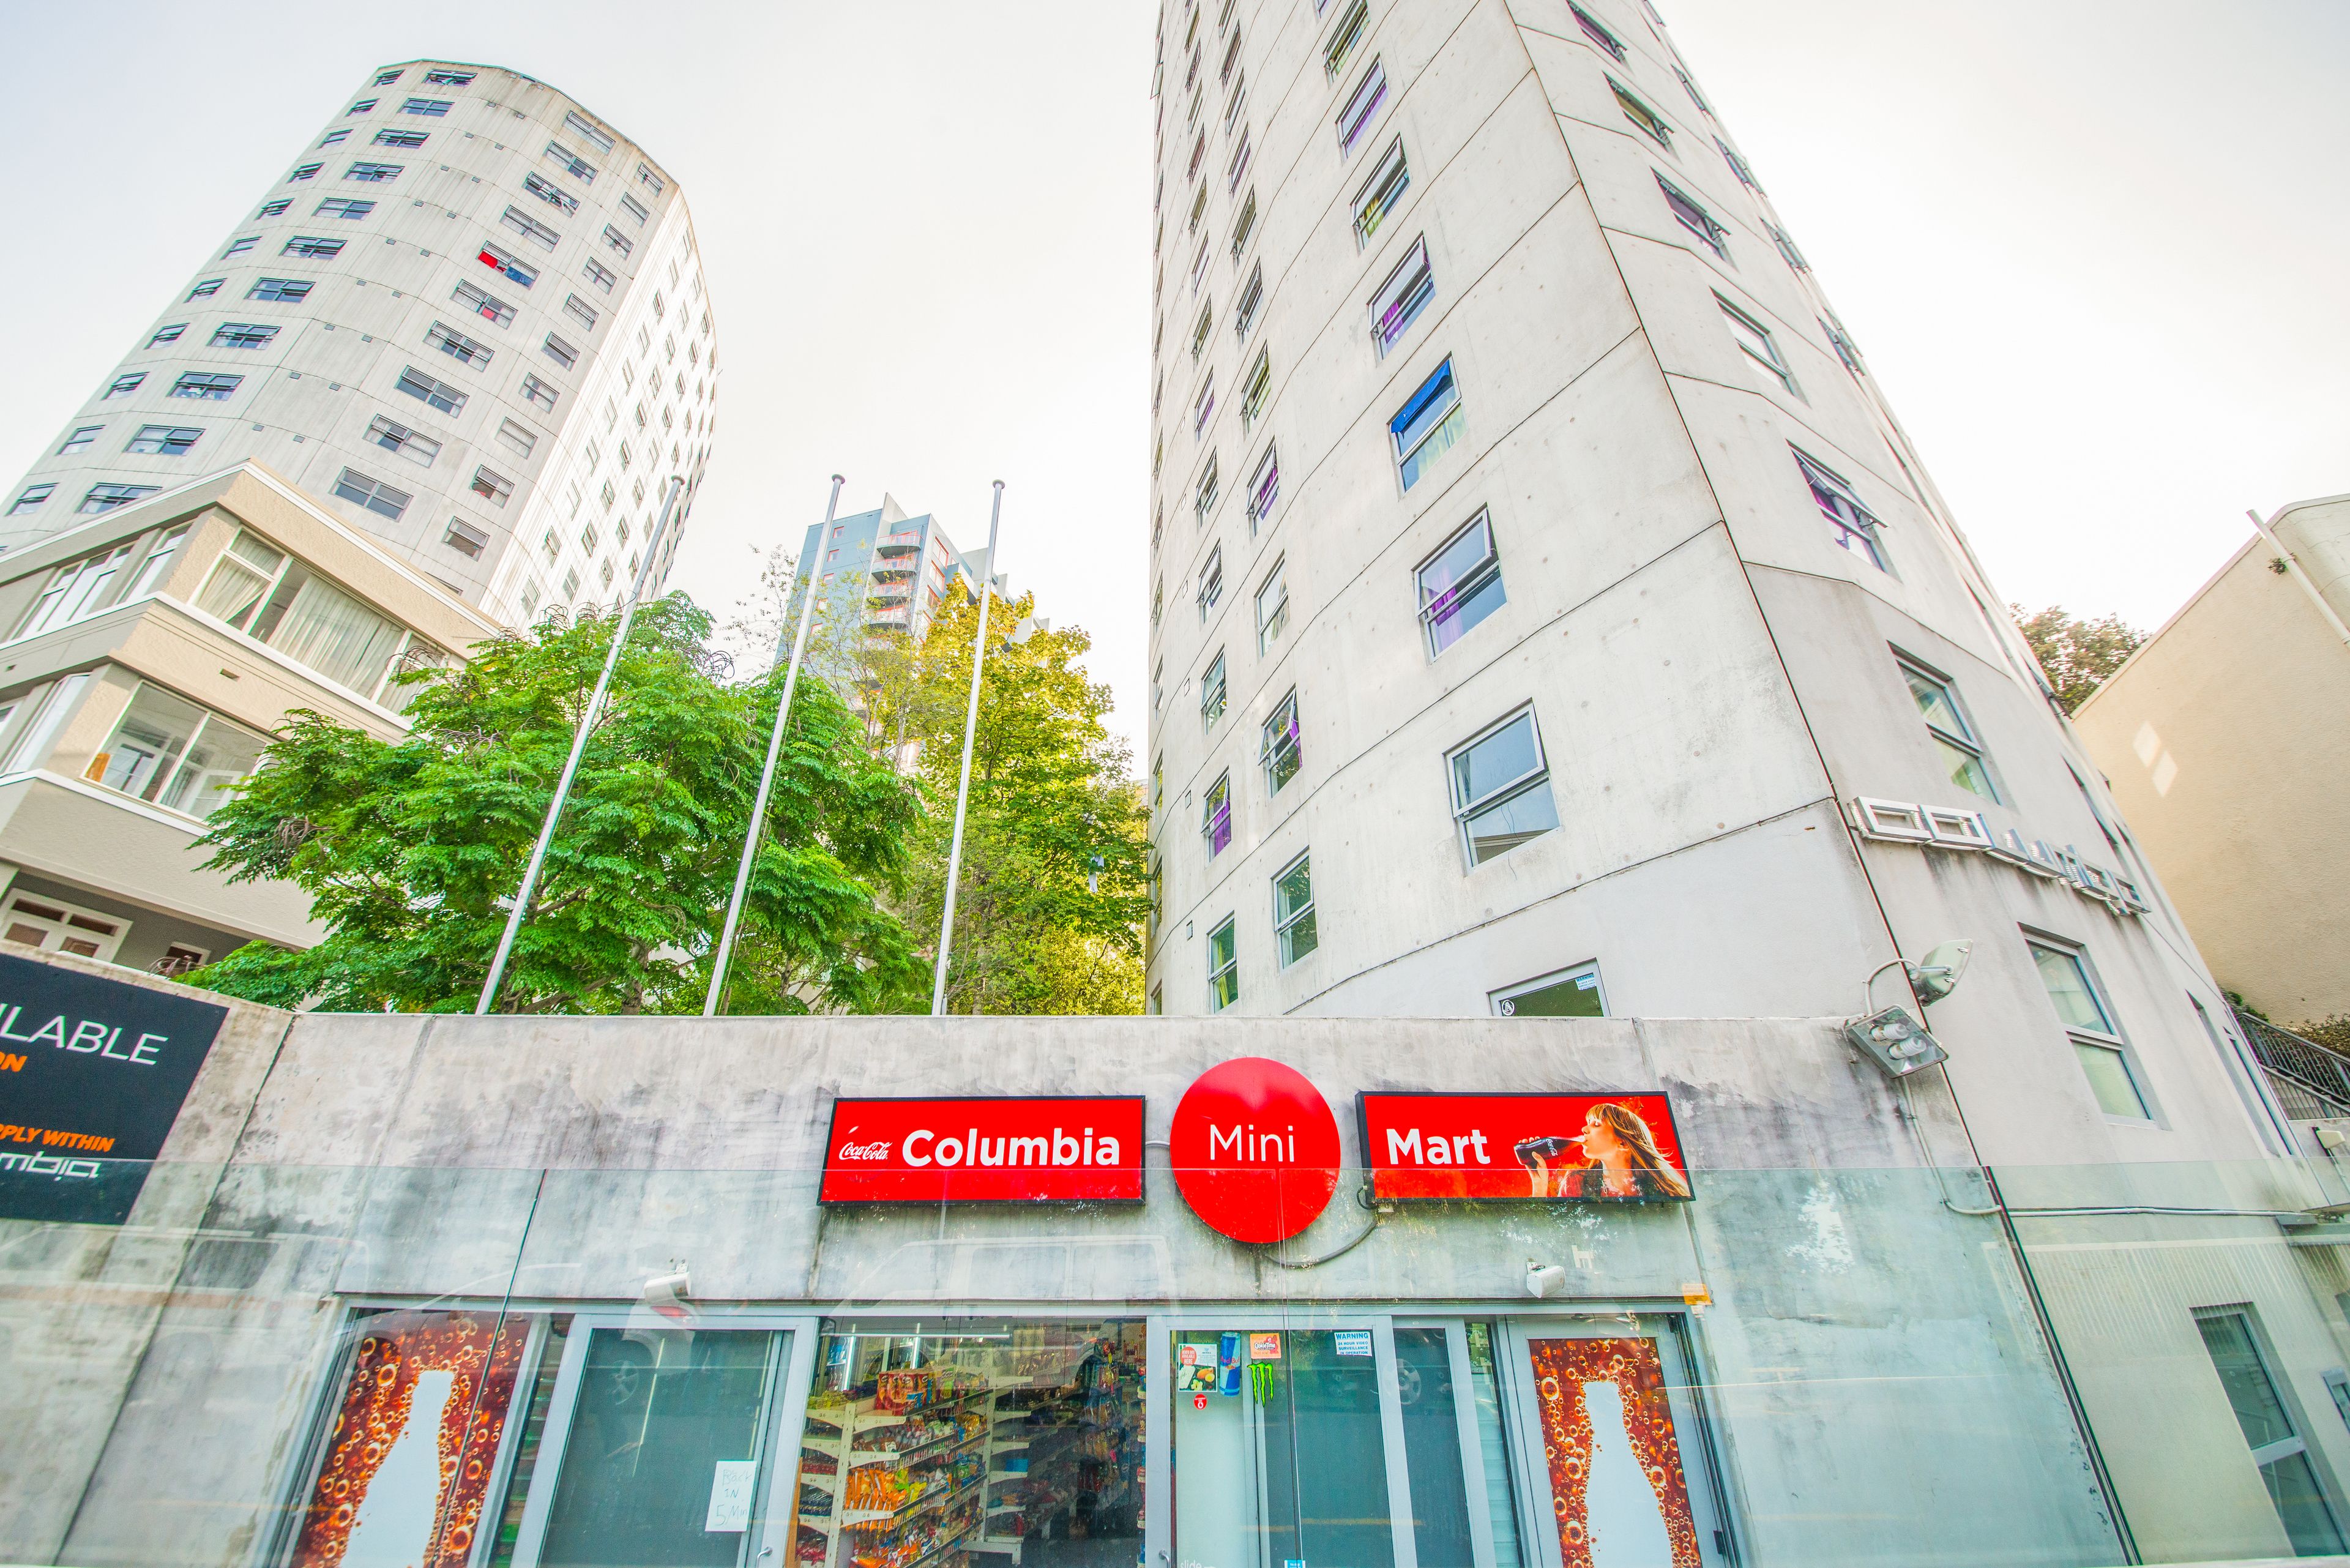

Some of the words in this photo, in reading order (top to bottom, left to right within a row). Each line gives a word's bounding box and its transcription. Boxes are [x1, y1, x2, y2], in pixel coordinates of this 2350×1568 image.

[42, 1130, 115, 1152] WITHIN
[839, 1141, 893, 1160] Coca-Cola
[902, 1127, 1120, 1167] Columbia
[1209, 1124, 1294, 1162] Mini
[1386, 1129, 1490, 1164] Mart
